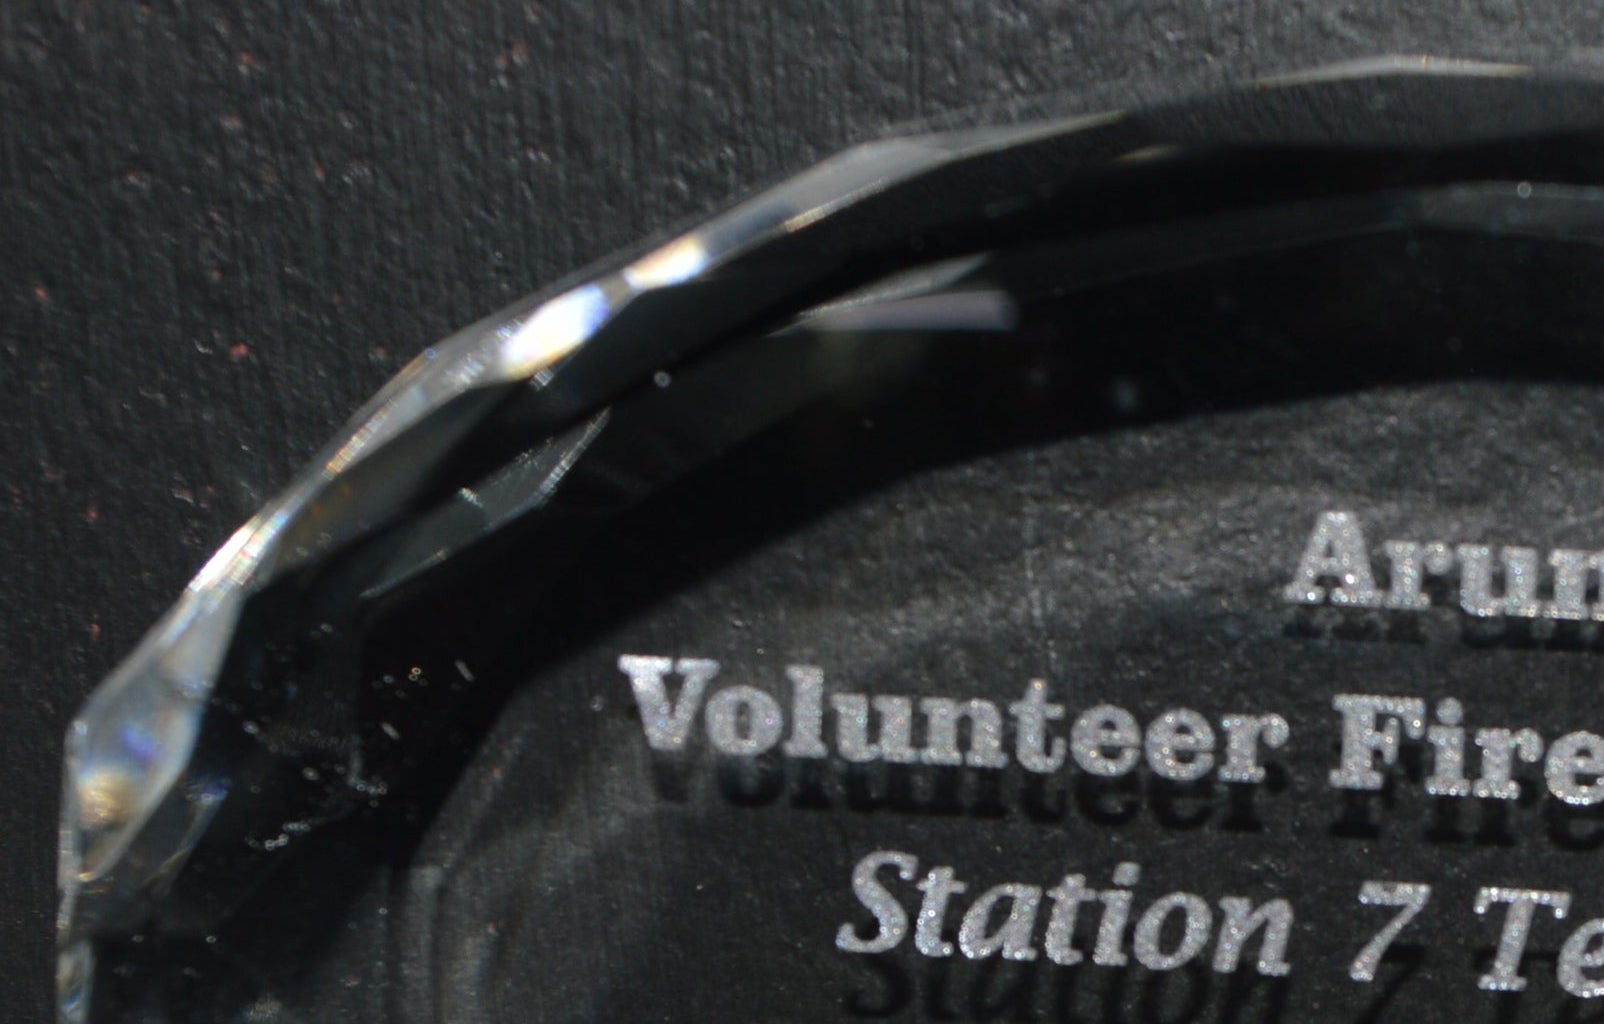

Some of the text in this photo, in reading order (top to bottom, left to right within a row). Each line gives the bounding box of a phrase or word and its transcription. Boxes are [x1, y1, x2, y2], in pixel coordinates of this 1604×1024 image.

[618, 655, 1289, 781] Volunteer
[836, 851, 1293, 976] Station
[1350, 881, 1431, 981] 7
